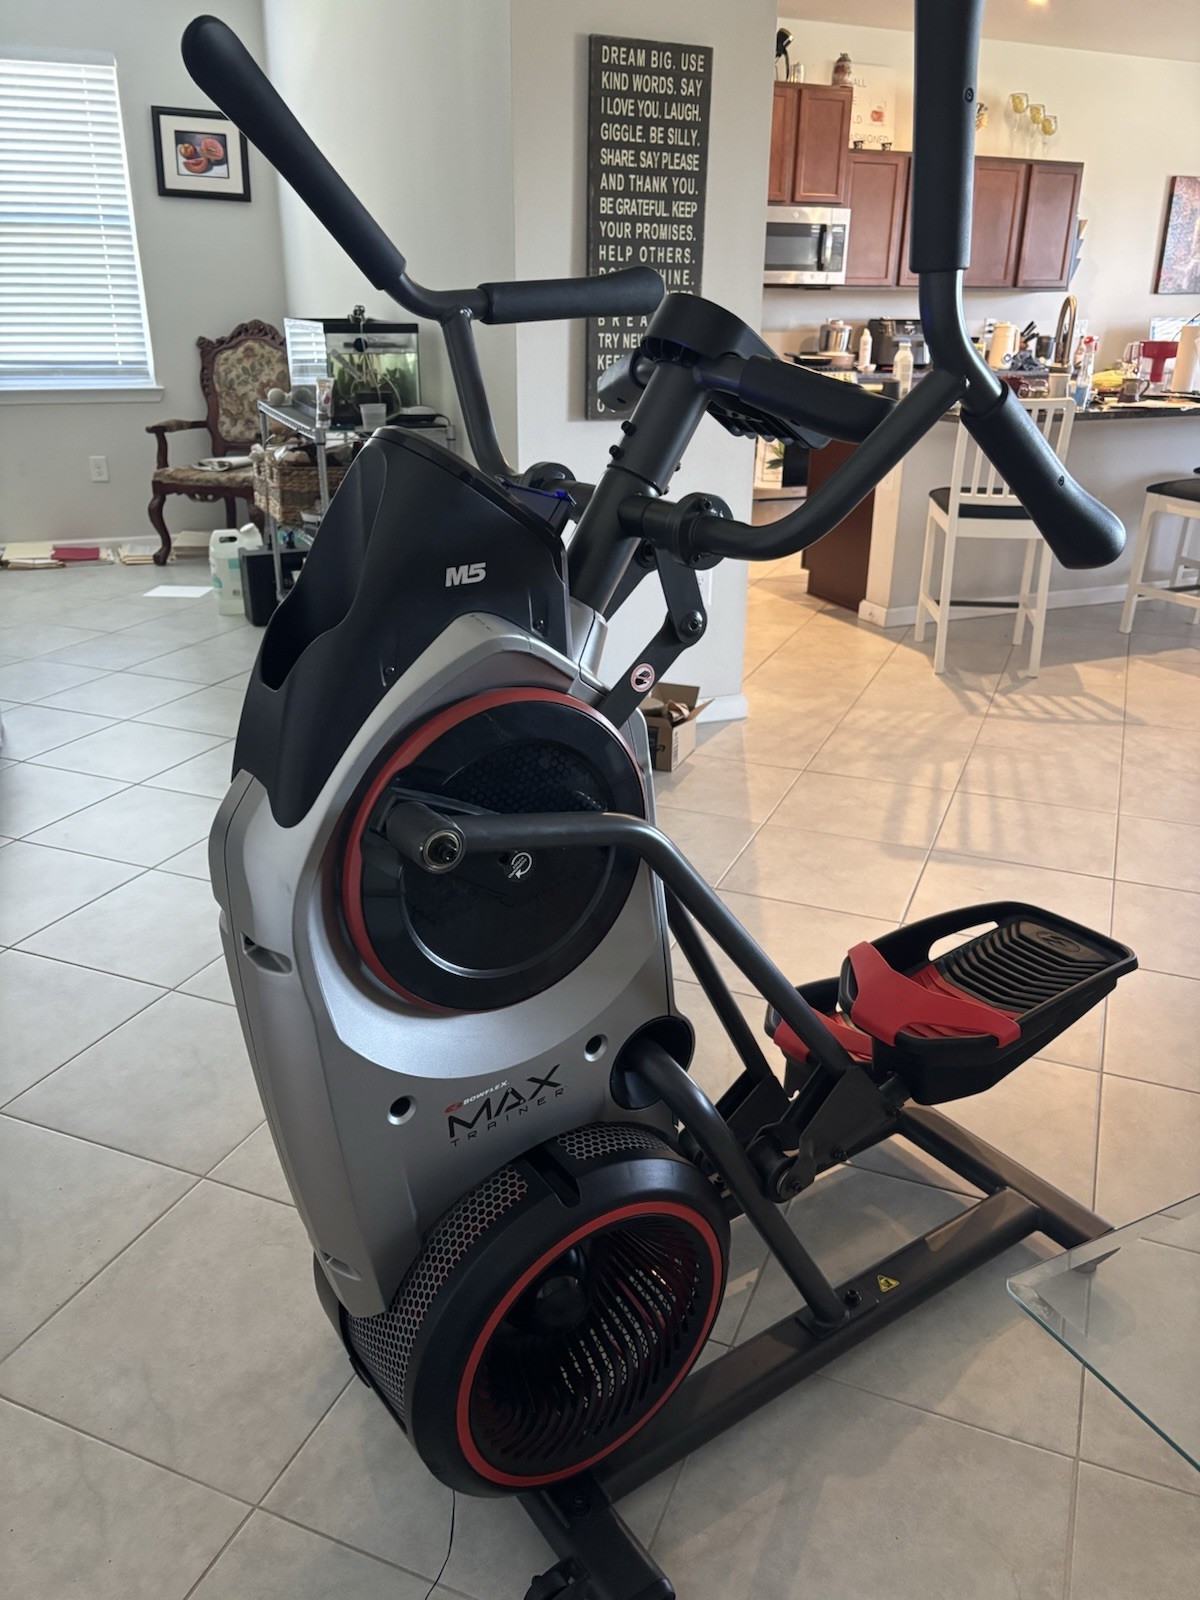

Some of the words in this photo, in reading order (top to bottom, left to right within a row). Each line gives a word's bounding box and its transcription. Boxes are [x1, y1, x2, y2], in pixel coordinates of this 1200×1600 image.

[601, 44, 646, 67] DREAM
[651, 50, 676, 70] BIG.
[680, 52, 704, 72] USE
[602, 71, 629, 91] KIND
[632, 74, 676, 95] WORDS.
[680, 78, 703, 97] SAY
[601, 97, 605, 114] I
[607, 97, 635, 117] LOVE
[637, 100, 661, 119] YOU.
[664, 102, 701, 121] LAUGH.
[601, 122, 646, 143] GIGGLE.
[650, 126, 664, 144] BE
[667, 128, 700, 147] SILLY.
[600, 148, 637, 167] SHARE.
[640, 151, 660, 169] SAY
[661, 152, 699, 172] PLEASE
[600, 173, 624, 191] AND
[629, 174, 668, 194] THANK
[672, 177, 698, 195] YOU.
[600, 197, 613, 214] BE
[616, 198, 669, 217] GRATEFUL.
[672, 201, 697, 218] KEEP
[600, 221, 632, 239] YOUR
[635, 223, 697, 241] PROMISES.
[599, 245, 633, 262] HELP
[639, 246, 696, 264] OTHERS.
[656, 269, 695, 286] HINE.
[598, 333, 620, 349] TRY
[445, 562, 487, 587] M5
[448, 1063, 561, 1138] MAX
[463, 1080, 509, 1105] BOWFLEX
[450, 1088, 565, 1147] TRAINER
